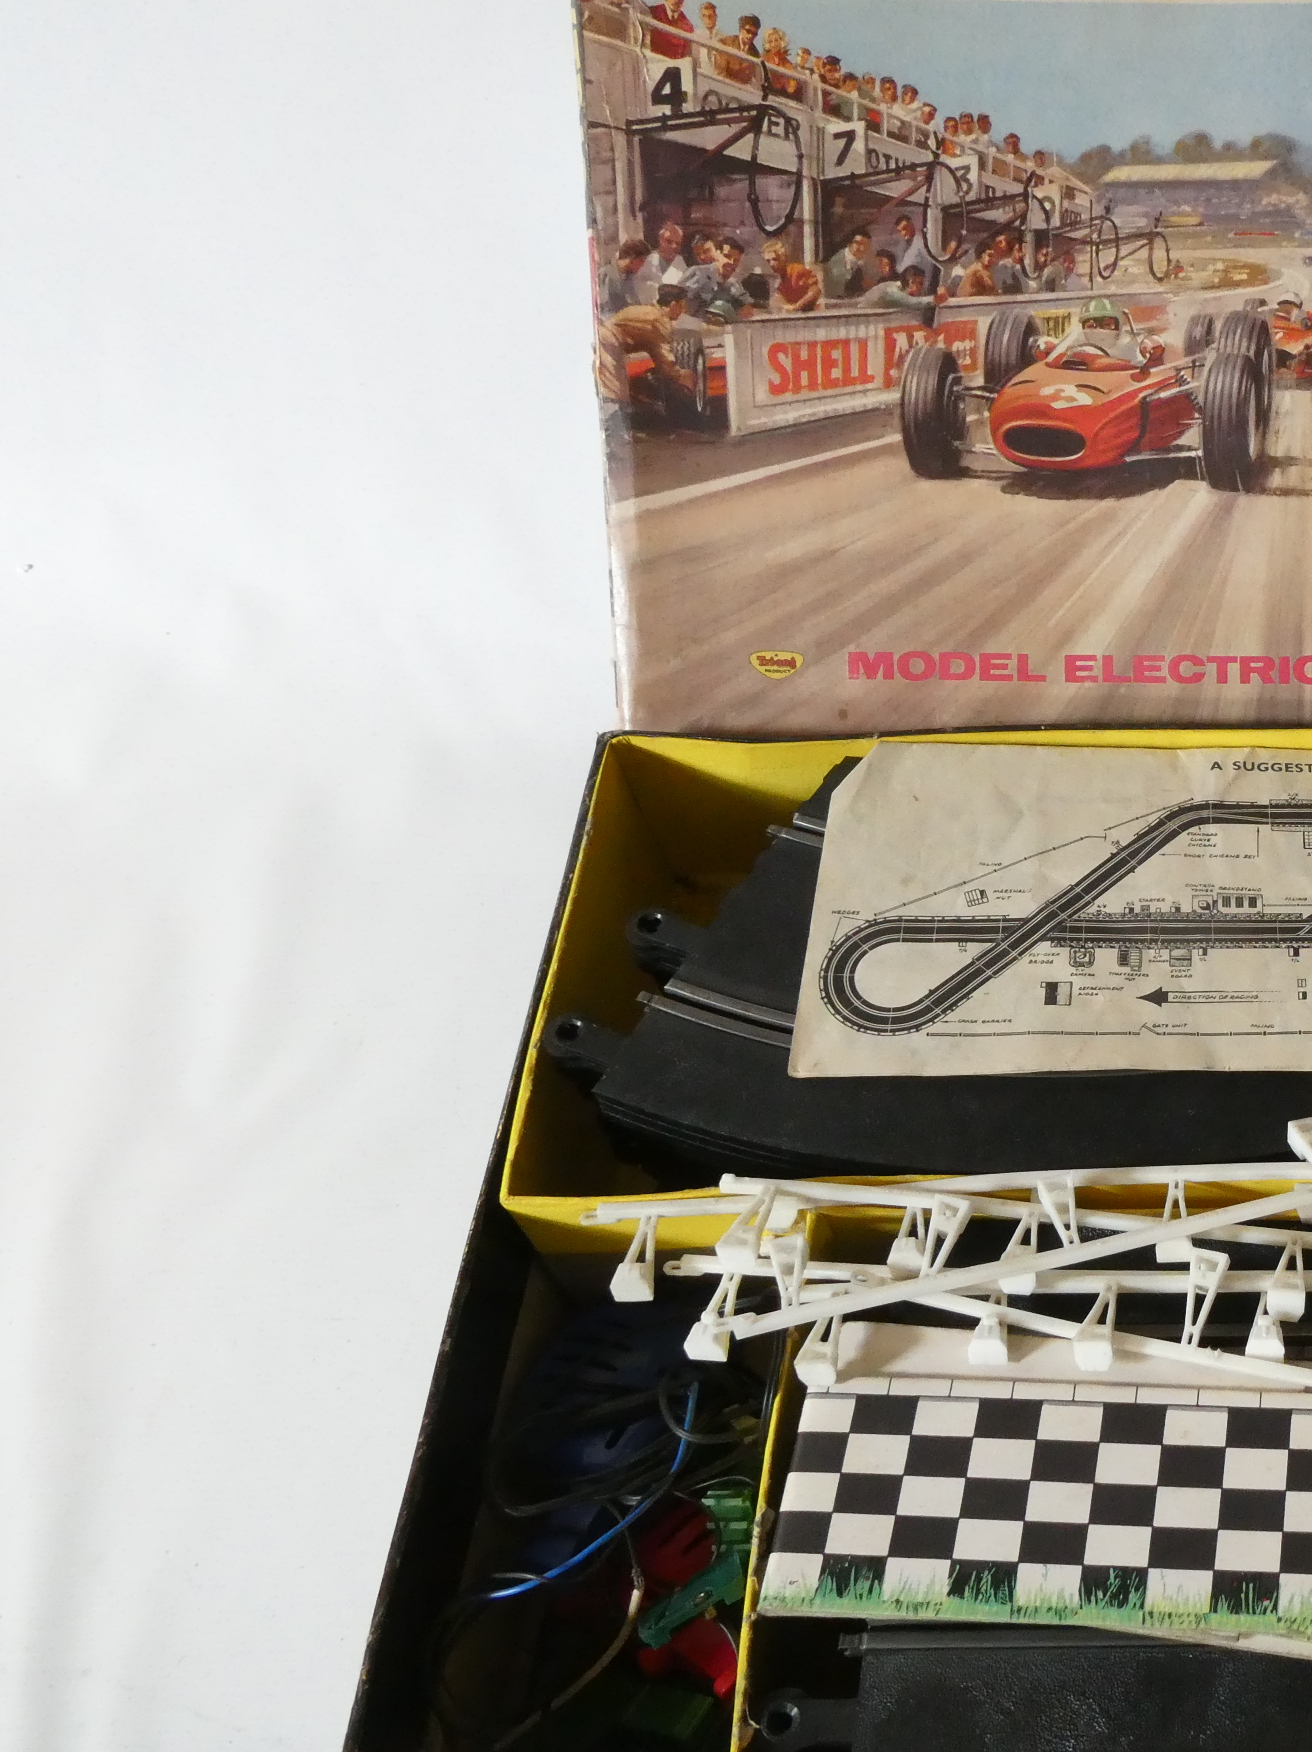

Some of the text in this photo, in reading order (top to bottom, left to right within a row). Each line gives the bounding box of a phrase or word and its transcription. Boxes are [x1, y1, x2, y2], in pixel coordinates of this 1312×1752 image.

[651, 66, 688, 114] 4
[832, 129, 856, 168] 7
[766, 337, 875, 397] SHELL
[1039, 383, 1094, 410] 3
[847, 651, 1047, 684] MODEL
[1210, 761, 1223, 771] A
